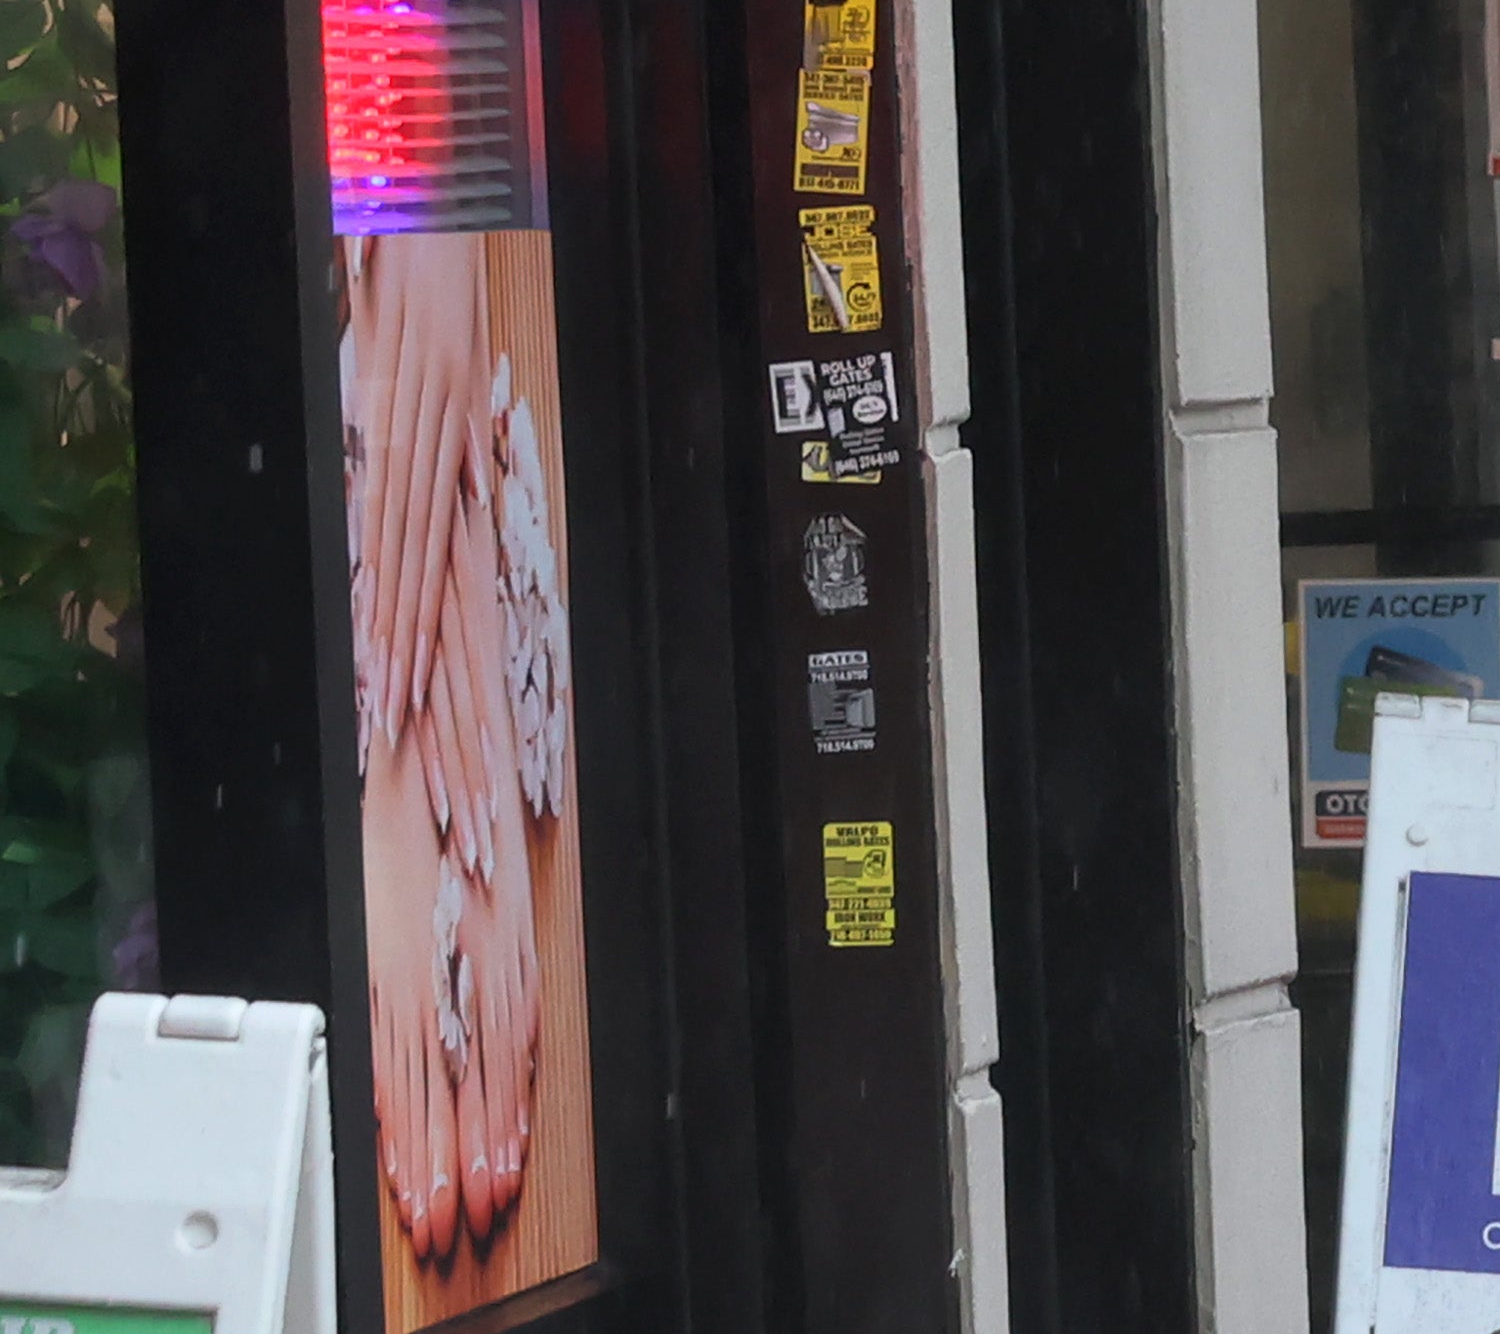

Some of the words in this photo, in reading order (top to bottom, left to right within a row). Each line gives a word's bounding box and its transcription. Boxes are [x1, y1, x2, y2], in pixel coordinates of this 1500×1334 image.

[820, 360, 855, 377] ROLL
[856, 354, 876, 369] UP
[828, 368, 873, 387] GATES
[1314, 595, 1361, 619] WE
[1367, 593, 1487, 618] ACCEPT
